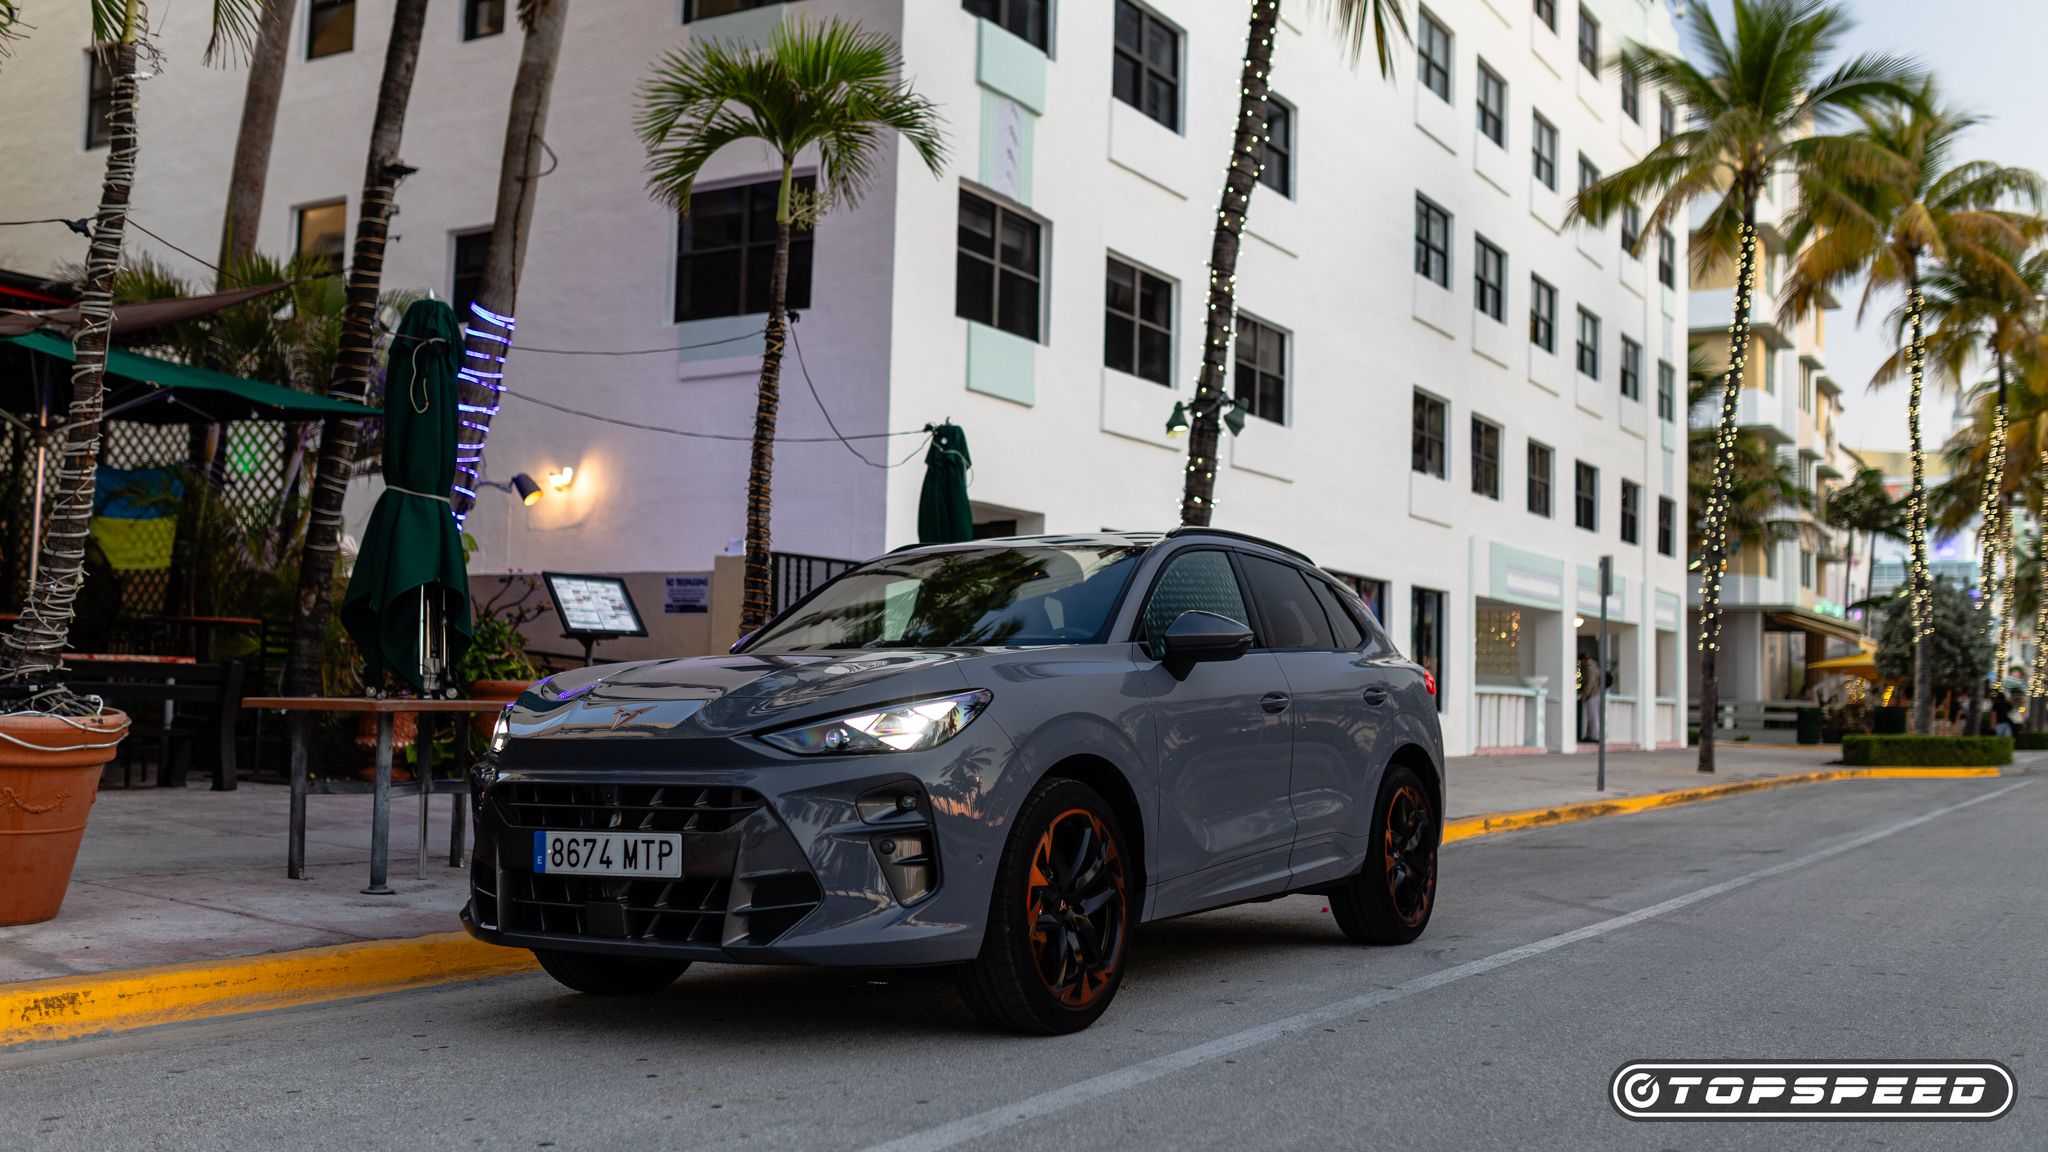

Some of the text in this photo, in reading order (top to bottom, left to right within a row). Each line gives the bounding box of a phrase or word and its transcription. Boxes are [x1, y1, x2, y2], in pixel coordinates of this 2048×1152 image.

[537, 856, 543, 865] E
[551, 838, 673, 871] 8674 MTP
